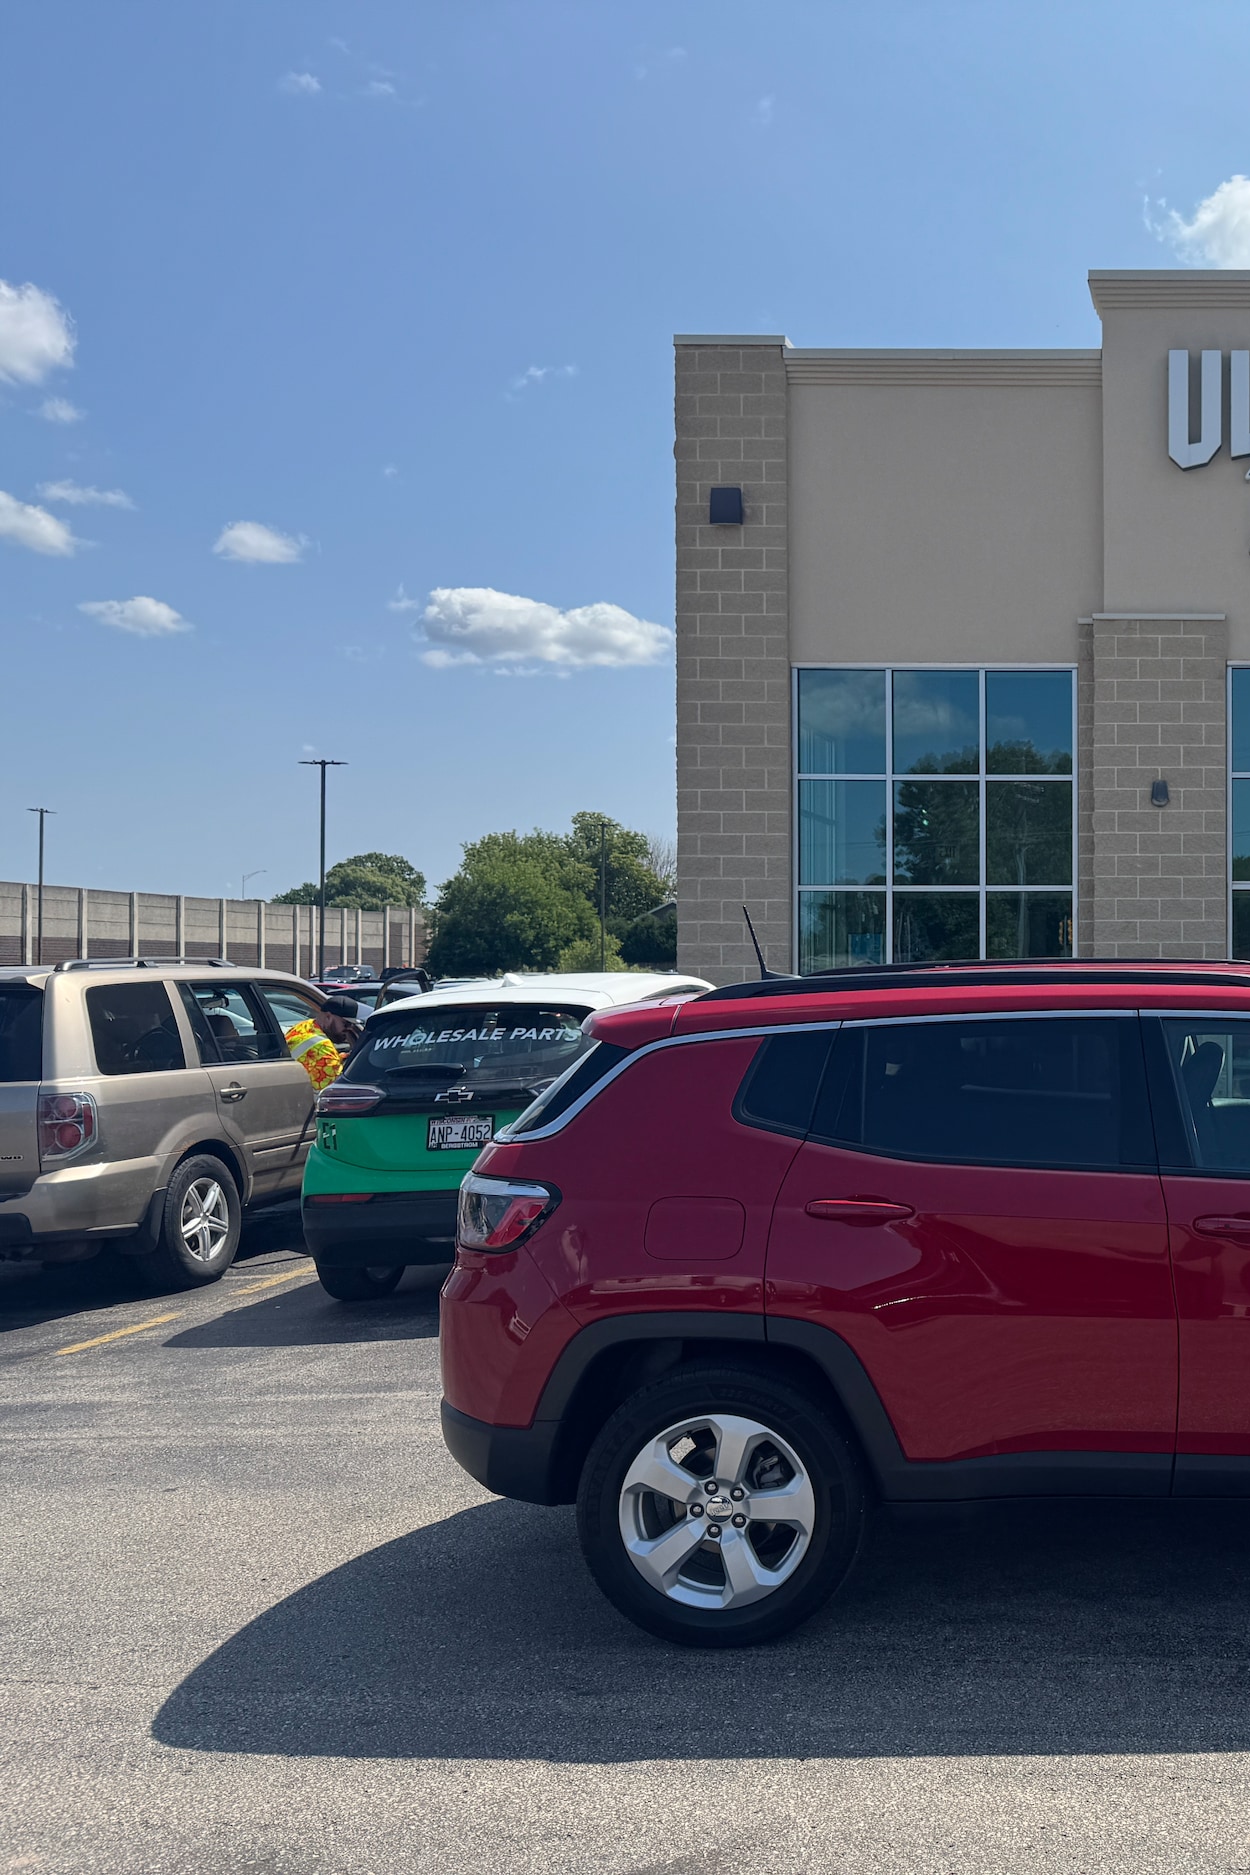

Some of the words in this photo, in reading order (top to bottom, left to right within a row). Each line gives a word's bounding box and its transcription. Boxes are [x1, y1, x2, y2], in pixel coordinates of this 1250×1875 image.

[374, 1028, 507, 1051] WHOLESALE
[509, 1027, 583, 1042] PARTS
[430, 1124, 491, 1143] ANP-4052
